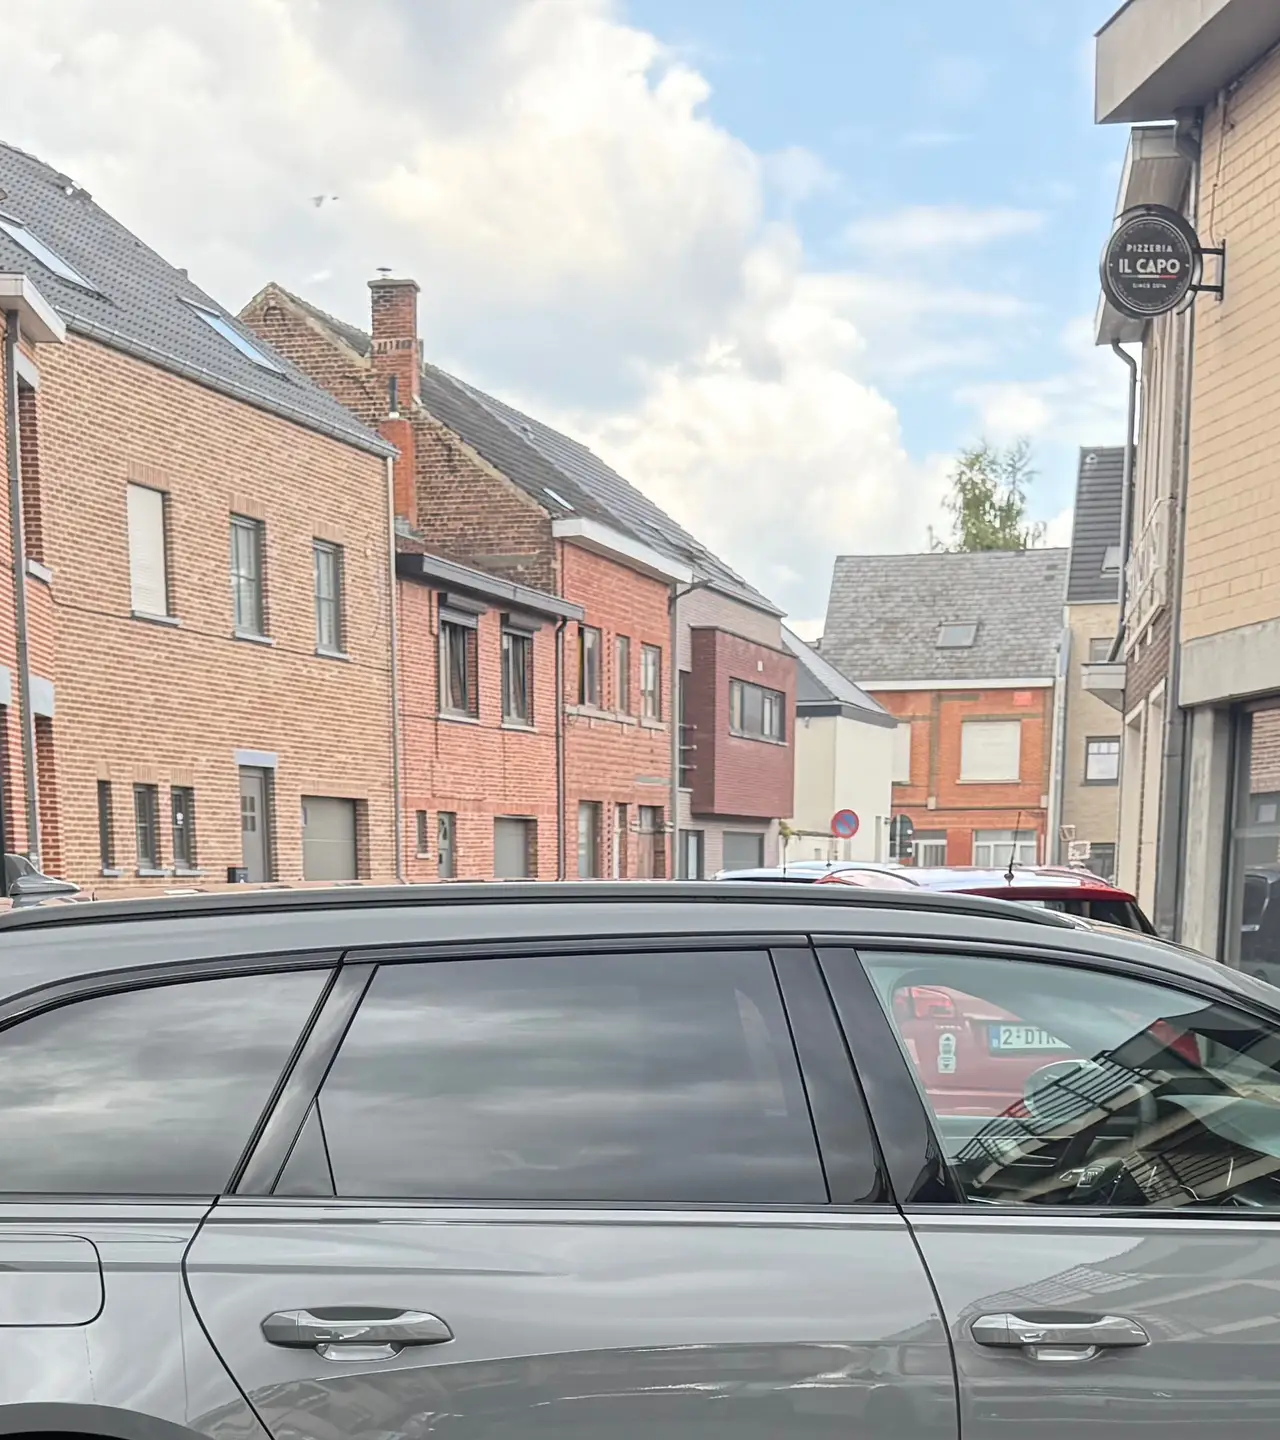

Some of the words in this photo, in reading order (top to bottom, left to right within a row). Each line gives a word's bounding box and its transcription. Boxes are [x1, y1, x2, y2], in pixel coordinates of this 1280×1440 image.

[1126, 244, 1173, 253] PIZZERIA
[1119, 259, 1132, 273] IL
[1136, 258, 1180, 274] CAPO
